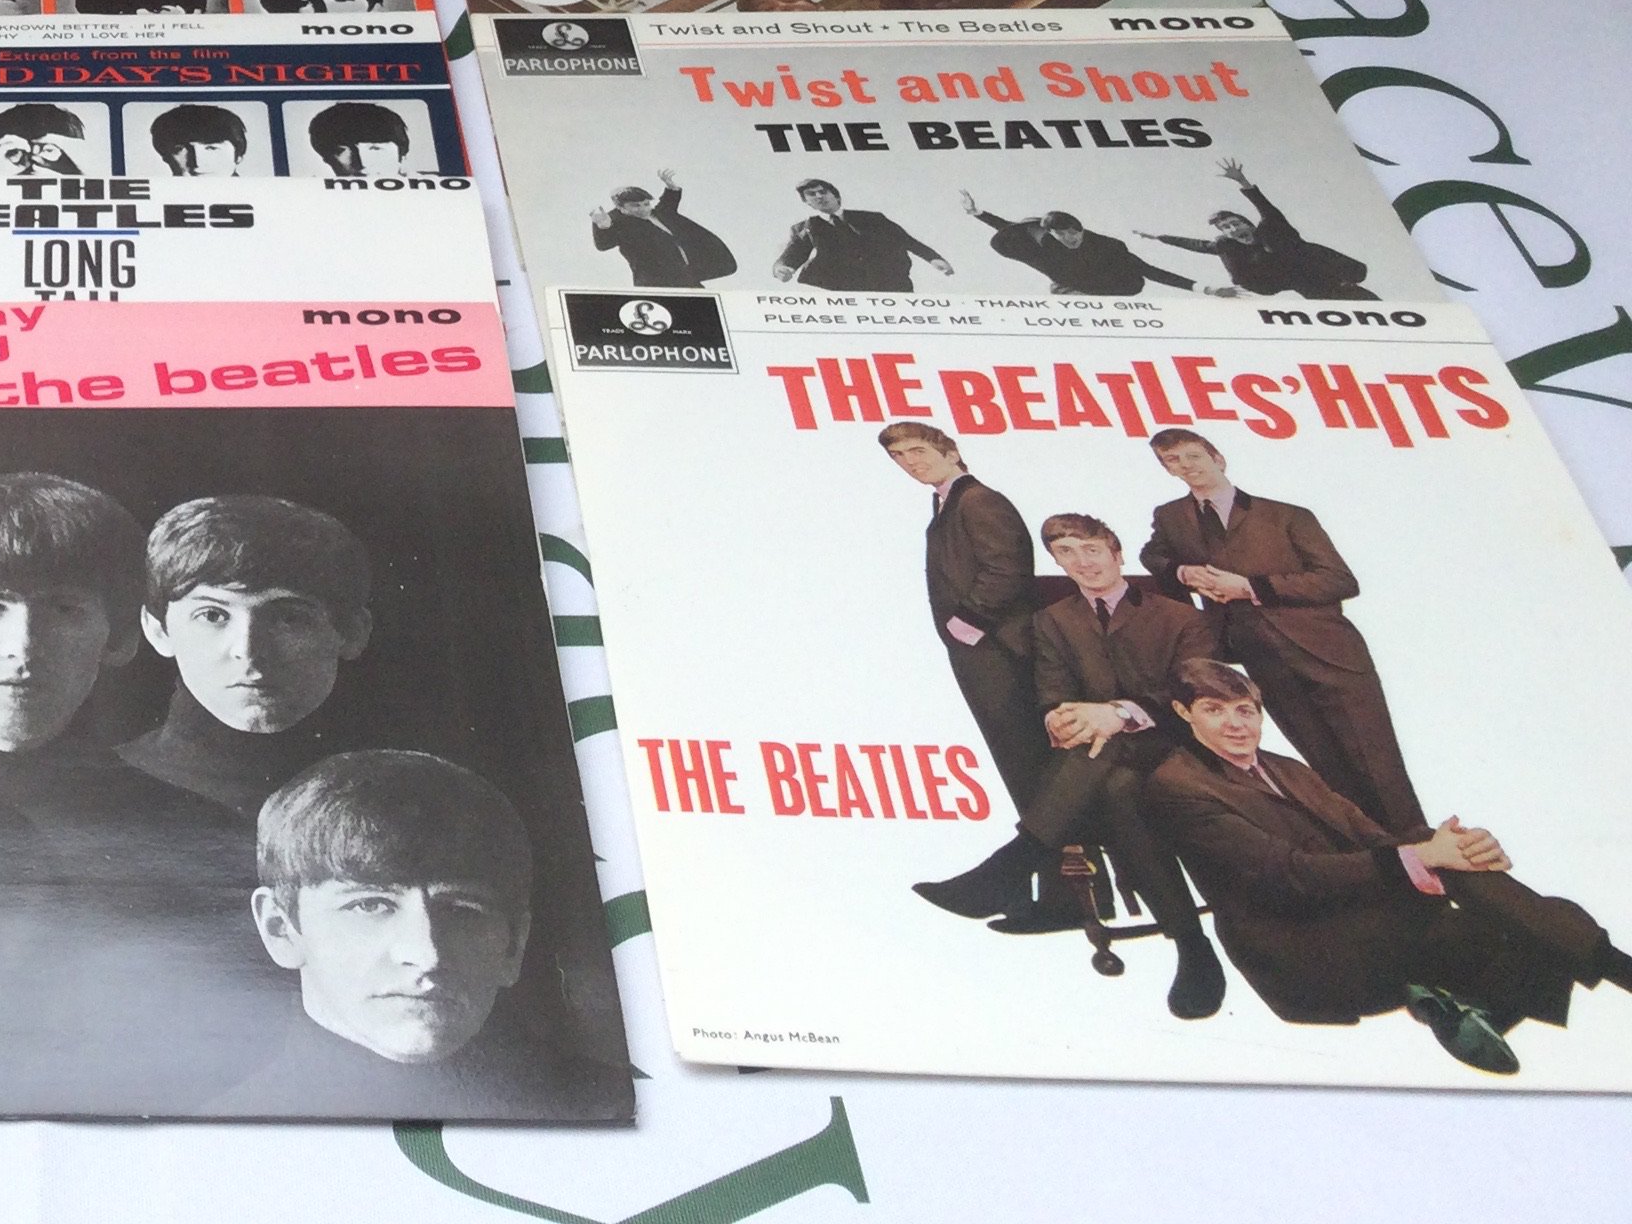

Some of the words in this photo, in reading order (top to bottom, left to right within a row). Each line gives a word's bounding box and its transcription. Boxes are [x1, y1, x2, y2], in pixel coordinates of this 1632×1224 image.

[301, 23, 415, 36] mono
[649, 24, 725, 37] Twist
[733, 23, 780, 35] and
[791, 21, 873, 35] Shout
[898, 20, 950, 34] The
[960, 19, 1064, 33] Beatles
[1111, 16, 1255, 30] mono
[91, 50, 138, 60] from
[150, 49, 182, 60] the
[193, 48, 230, 59] film
[47, 65, 213, 84] DAY'S
[228, 63, 422, 83] NIGHT
[504, 57, 641, 72] PARLOPHONE
[678, 64, 877, 108] Twist
[897, 66, 1025, 103] and
[1038, 60, 1250, 103] Shout
[755, 122, 890, 152] THE
[908, 117, 1213, 151] BEATLES
[5, 178, 152, 200] THE
[324, 176, 472, 191] mono
[24, 239, 137, 290] LONG
[756, 296, 817, 306] FROM
[827, 297, 857, 307] ME
[867, 298, 896, 307] TO
[905, 298, 950, 308] YOU
[975, 299, 1051, 309] THANK
[1058, 300, 1104, 310] YOU
[1114, 301, 1162, 311] GIRL
[300, 307, 463, 326] mono
[764, 314, 848, 325] PLEASE
[856, 315, 941, 325] PLEASE
[950, 316, 982, 325] ME
[1025, 317, 1083, 327] LOVE
[1092, 318, 1124, 328] ME
[1133, 319, 1165, 329] DO
[1259, 308, 1428, 328] mono
[575, 343, 730, 363] PARLOPHONE
[155, 341, 484, 398] beatles
[766, 353, 932, 430] THE
[637, 739, 745, 814] THE
[760, 742, 991, 821] BEATLES
[692, 1027, 739, 1040] Photo:
[744, 1029, 784, 1043] Angus
[789, 1032, 840, 1045] McBean
